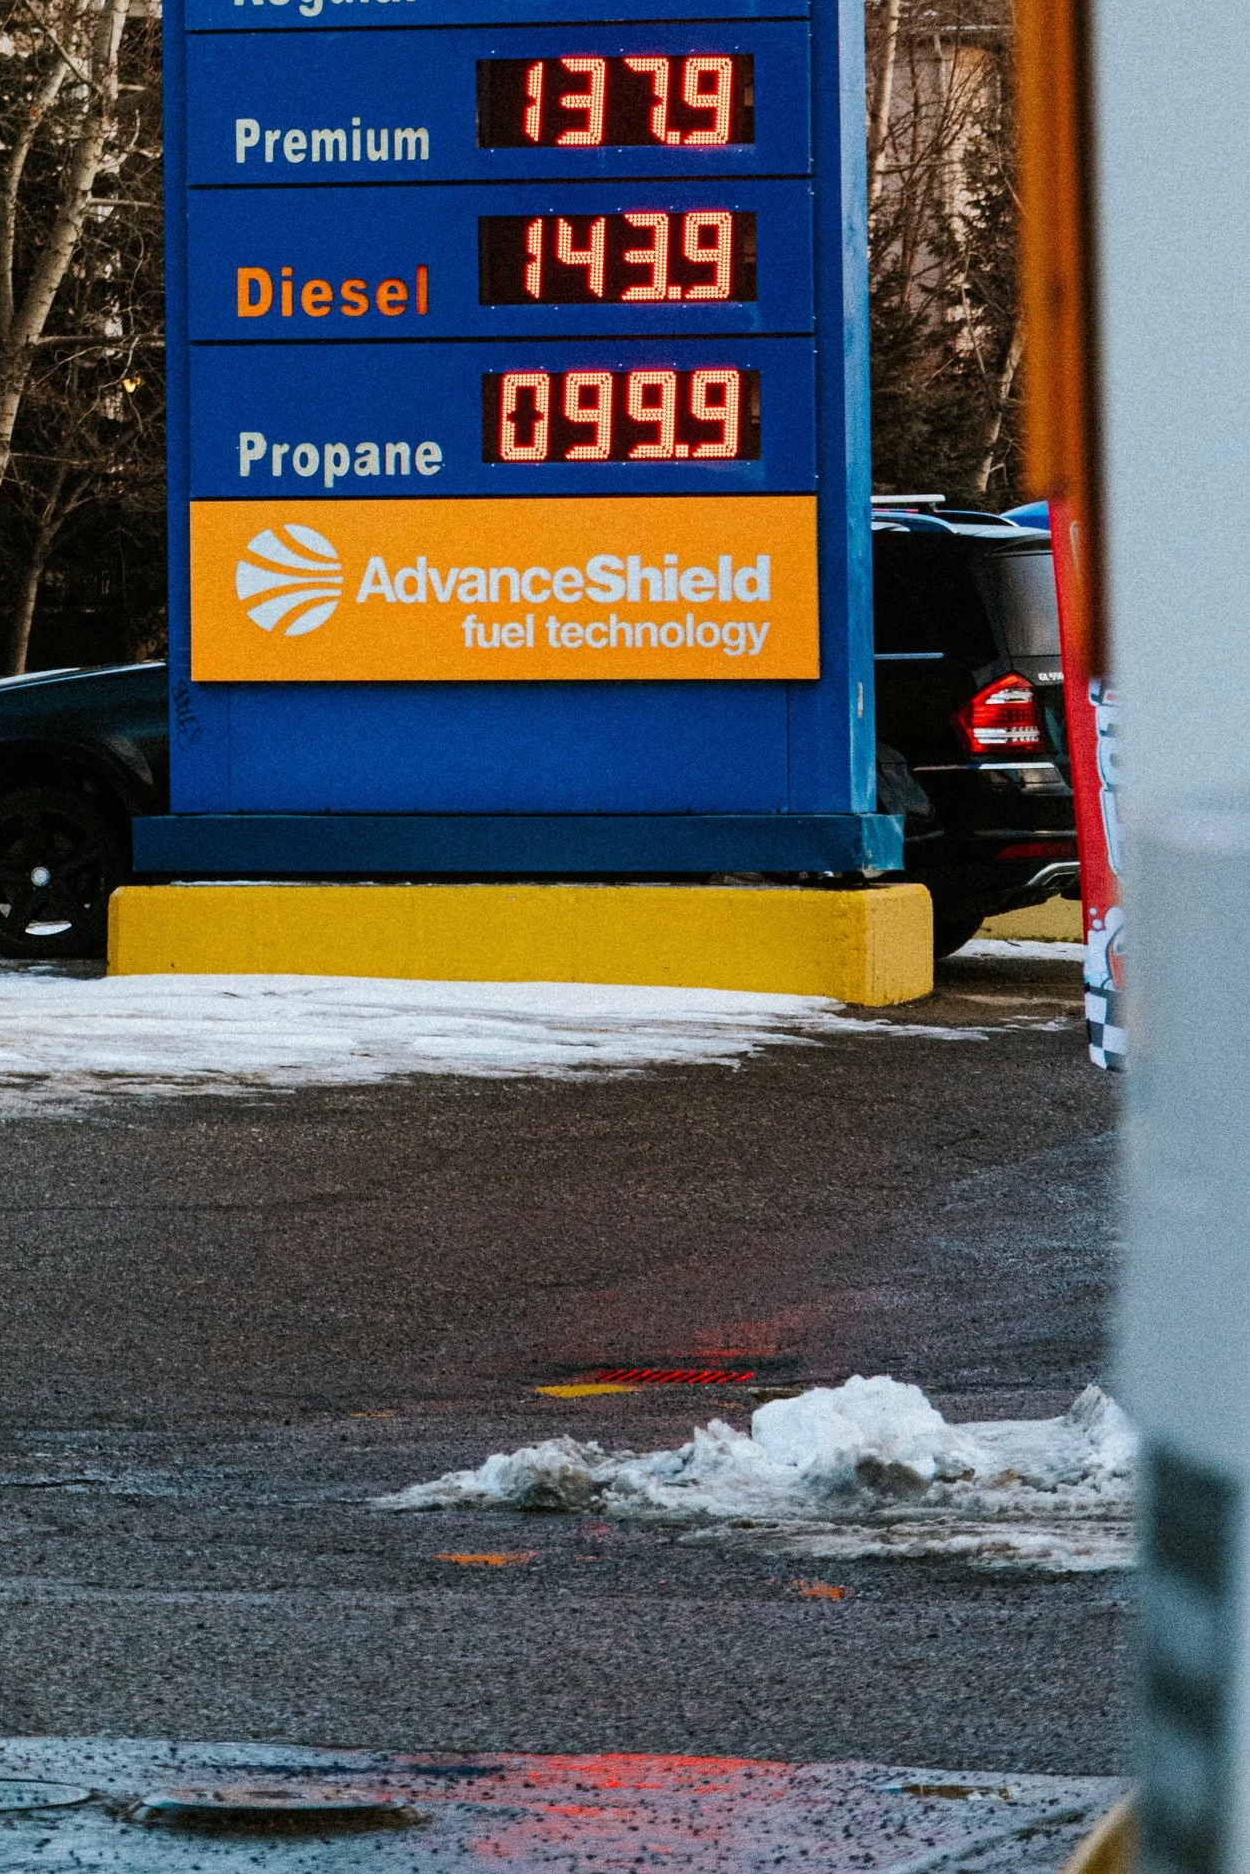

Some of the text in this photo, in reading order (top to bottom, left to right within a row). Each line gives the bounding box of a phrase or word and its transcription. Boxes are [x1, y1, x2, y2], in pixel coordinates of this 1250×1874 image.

[525, 57, 734, 146] 137.9
[235, 117, 430, 164] Premium
[526, 212, 734, 301] 143.9
[236, 265, 429, 319] Diesel
[501, 370, 741, 461] 099.9
[239, 432, 443, 488] Propane
[356, 553, 772, 605] AdvanceShield
[461, 613, 771, 658] fuel technology
